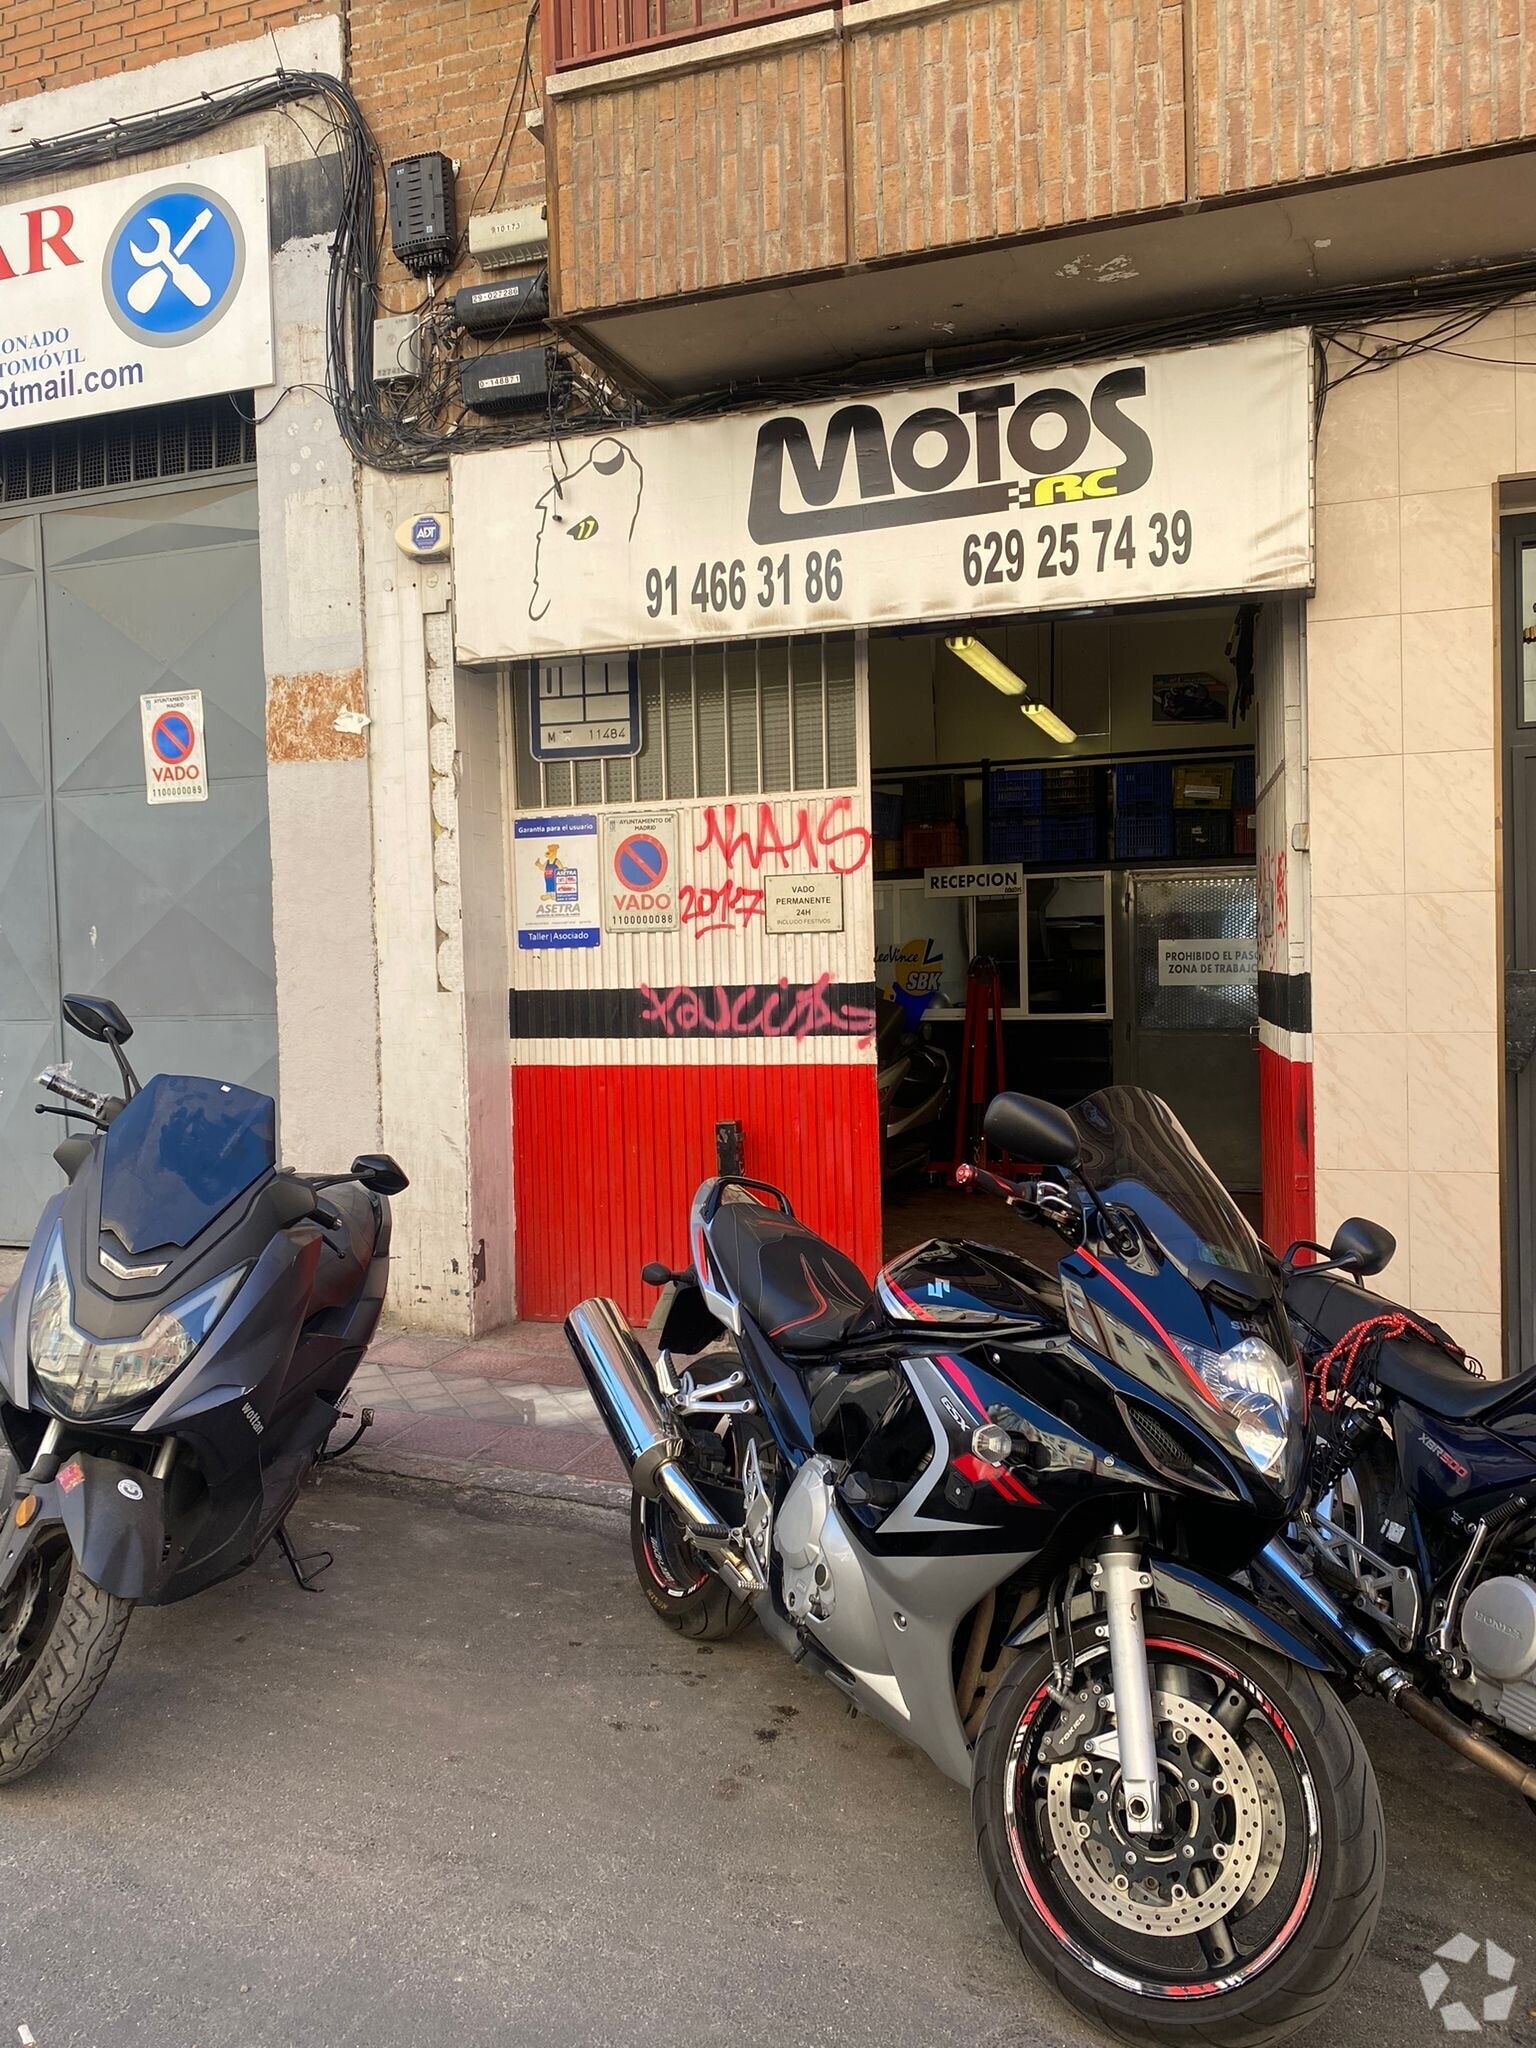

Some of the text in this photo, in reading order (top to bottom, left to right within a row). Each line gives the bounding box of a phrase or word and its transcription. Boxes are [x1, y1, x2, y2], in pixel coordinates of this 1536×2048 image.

[1, 327, 69, 354] ONADO
[748, 366, 1153, 545] MOTOS
[1034, 467, 1118, 506] RC
[416, 526, 436, 538] ADT
[962, 509, 1193, 587] 629 25 74 39
[645, 548, 843, 618] 91 466 31 86
[153, 695, 190, 704] AYUNTAMIENTO
[547, 727, 625, 743] M 11484
[153, 765, 199, 782] VADO
[546, 825, 560, 833] para
[561, 823, 568, 831] el
[569, 823, 593, 831] usuario
[619, 817, 663, 825] AYUNTAMIENTO
[929, 871, 1018, 890] RECEPCION
[791, 885, 815, 894] VADO
[613, 893, 672, 911] VADO
[775, 896, 832, 905] PERMANENTE
[536, 903, 581, 914] ASETRA
[796, 908, 811, 916] 24H
[528, 931, 589, 941] Taller Asociado
[1165, 951, 1220, 961] PROHIBIDO
[1222, 951, 1232, 960] EL
[1168, 964, 1198, 974] ZONA
[1200, 963, 1213, 973] DE
[906, 971, 943, 991] SBK
[1473, 1610, 1522, 1640] HONDA
